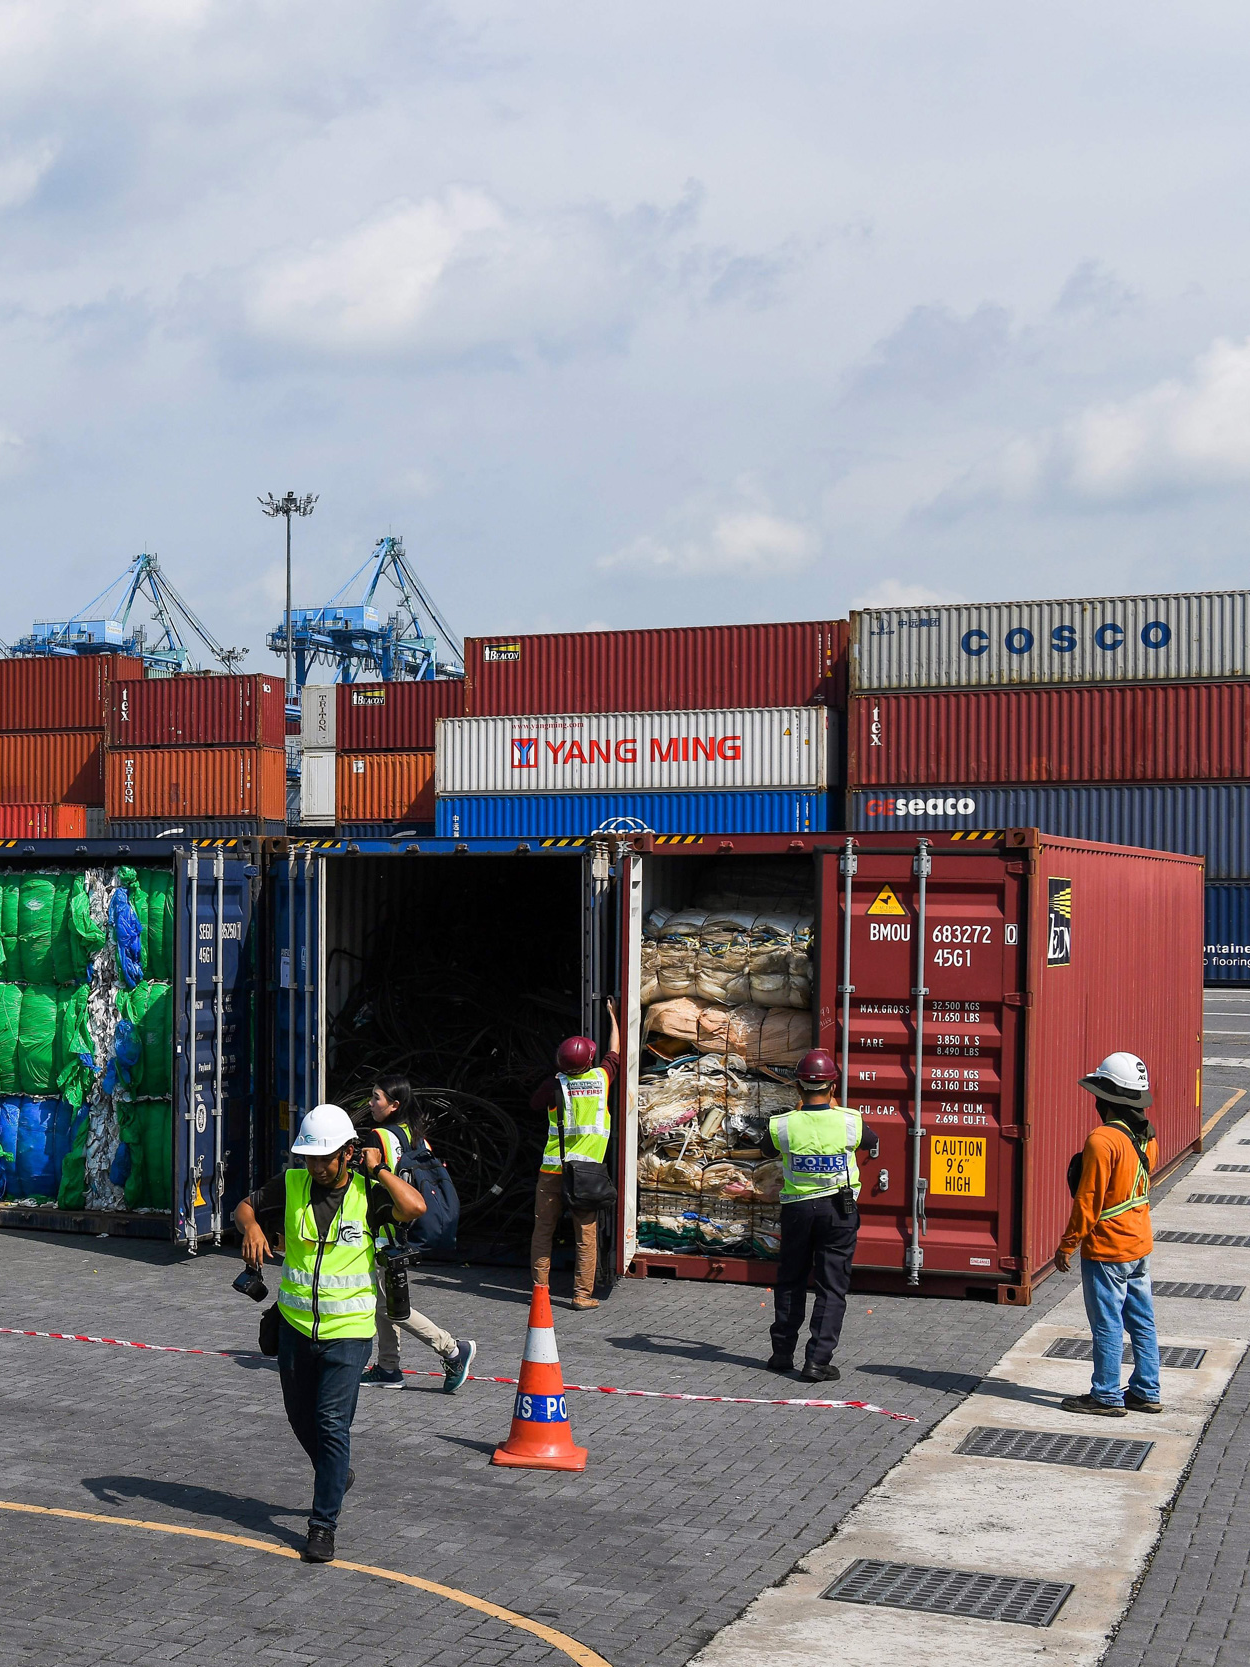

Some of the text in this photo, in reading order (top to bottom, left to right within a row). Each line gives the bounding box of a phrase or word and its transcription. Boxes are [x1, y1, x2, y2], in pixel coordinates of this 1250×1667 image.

[961, 621, 1172, 656] COSCO
[490, 651, 519, 660] BEACON
[121, 688, 130, 721] tex
[319, 695, 327, 731] TRITON
[512, 722, 584, 731] www.yangming.com
[870, 706, 883, 746] tex
[545, 736, 742, 765] YANG MING
[125, 759, 134, 803] TRITON
[870, 923, 911, 941] BMOU
[932, 925, 992, 944] 683272
[199, 946, 213, 963] 45G1
[1203, 943, 1250, 953] ntaine
[934, 949, 971, 967] 45G1
[860, 1001, 980, 1014] MAX.GROSS 32.500 KGS
[932, 1012, 980, 1023] 71.650 LBS
[860, 1038, 884, 1048] TARE
[937, 1035, 960, 1045] 3.850
[937, 1047, 979, 1056] 8.490 LBS
[859, 1069, 979, 1082] NET 28.650 KGS
[931, 1080, 979, 1092] 63.160 LBS
[877, 1106, 897, 1116] CAP.
[941, 1102, 958, 1113] 76.4
[963, 1103, 986, 1114] CU.M.
[935, 1114, 989, 1126] 2.698 CU.FT.
[934, 1140, 983, 1157] CAUTION
[793, 1156, 844, 1167] POLIS
[945, 1176, 971, 1193] HIGH
